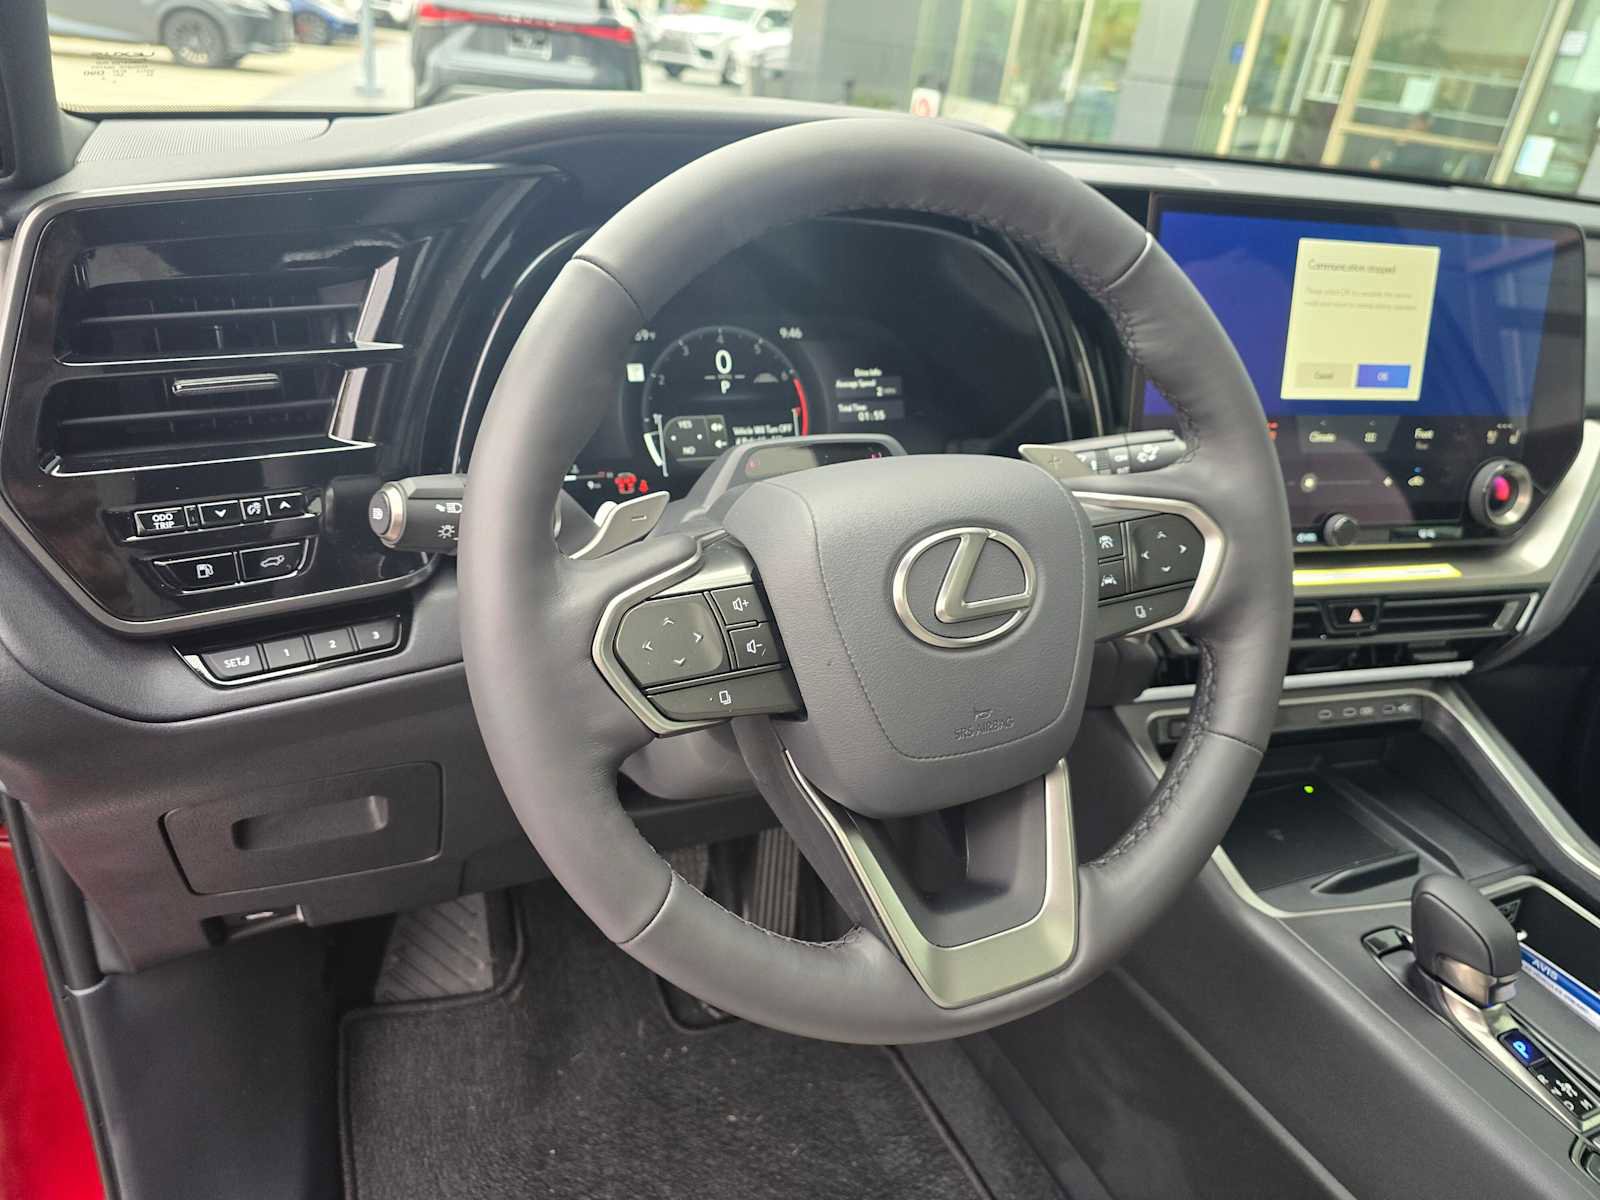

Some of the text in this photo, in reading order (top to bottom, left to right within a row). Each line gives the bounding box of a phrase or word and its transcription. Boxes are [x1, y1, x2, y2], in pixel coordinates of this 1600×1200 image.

[779, 327, 803, 340] 9:46
[715, 349, 732, 374] 0
[1376, 371, 1389, 382] OK
[720, 379, 731, 394] P
[857, 409, 887, 422] 01:55
[677, 420, 693, 430] YES
[682, 446, 696, 455] NO
[151, 512, 174, 523] ODO
[153, 520, 176, 531] TRIP
[371, 630, 380, 640] 3
[328, 639, 337, 649] 2
[283, 648, 290, 657] 1
[223, 658, 242, 669] SET
[953, 716, 1015, 741] SRS AIRBAG
[1532, 958, 1558, 981] AVIS
[1512, 1040, 1529, 1059] P
[1536, 1074, 1549, 1085] R
[1563, 1100, 1575, 1112] D
